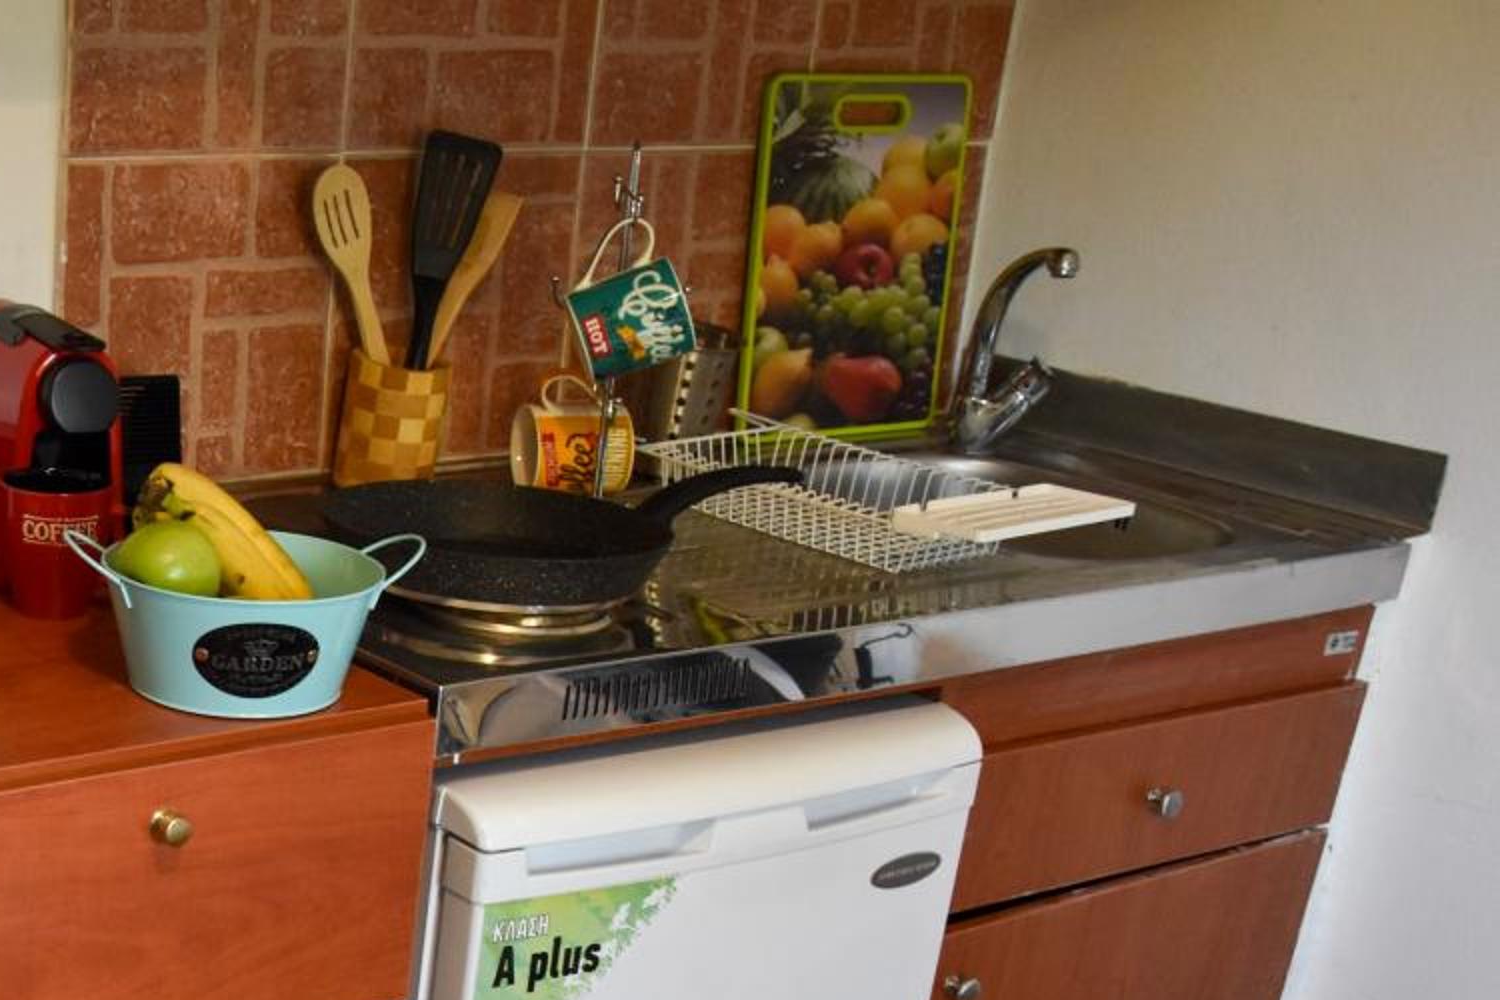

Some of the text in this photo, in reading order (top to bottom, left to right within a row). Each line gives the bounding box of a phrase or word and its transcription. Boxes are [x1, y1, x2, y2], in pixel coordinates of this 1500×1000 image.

[584, 317, 609, 353] HOT
[211, 653, 304, 673] GARDEN
[491, 936, 601, 992] A plus
